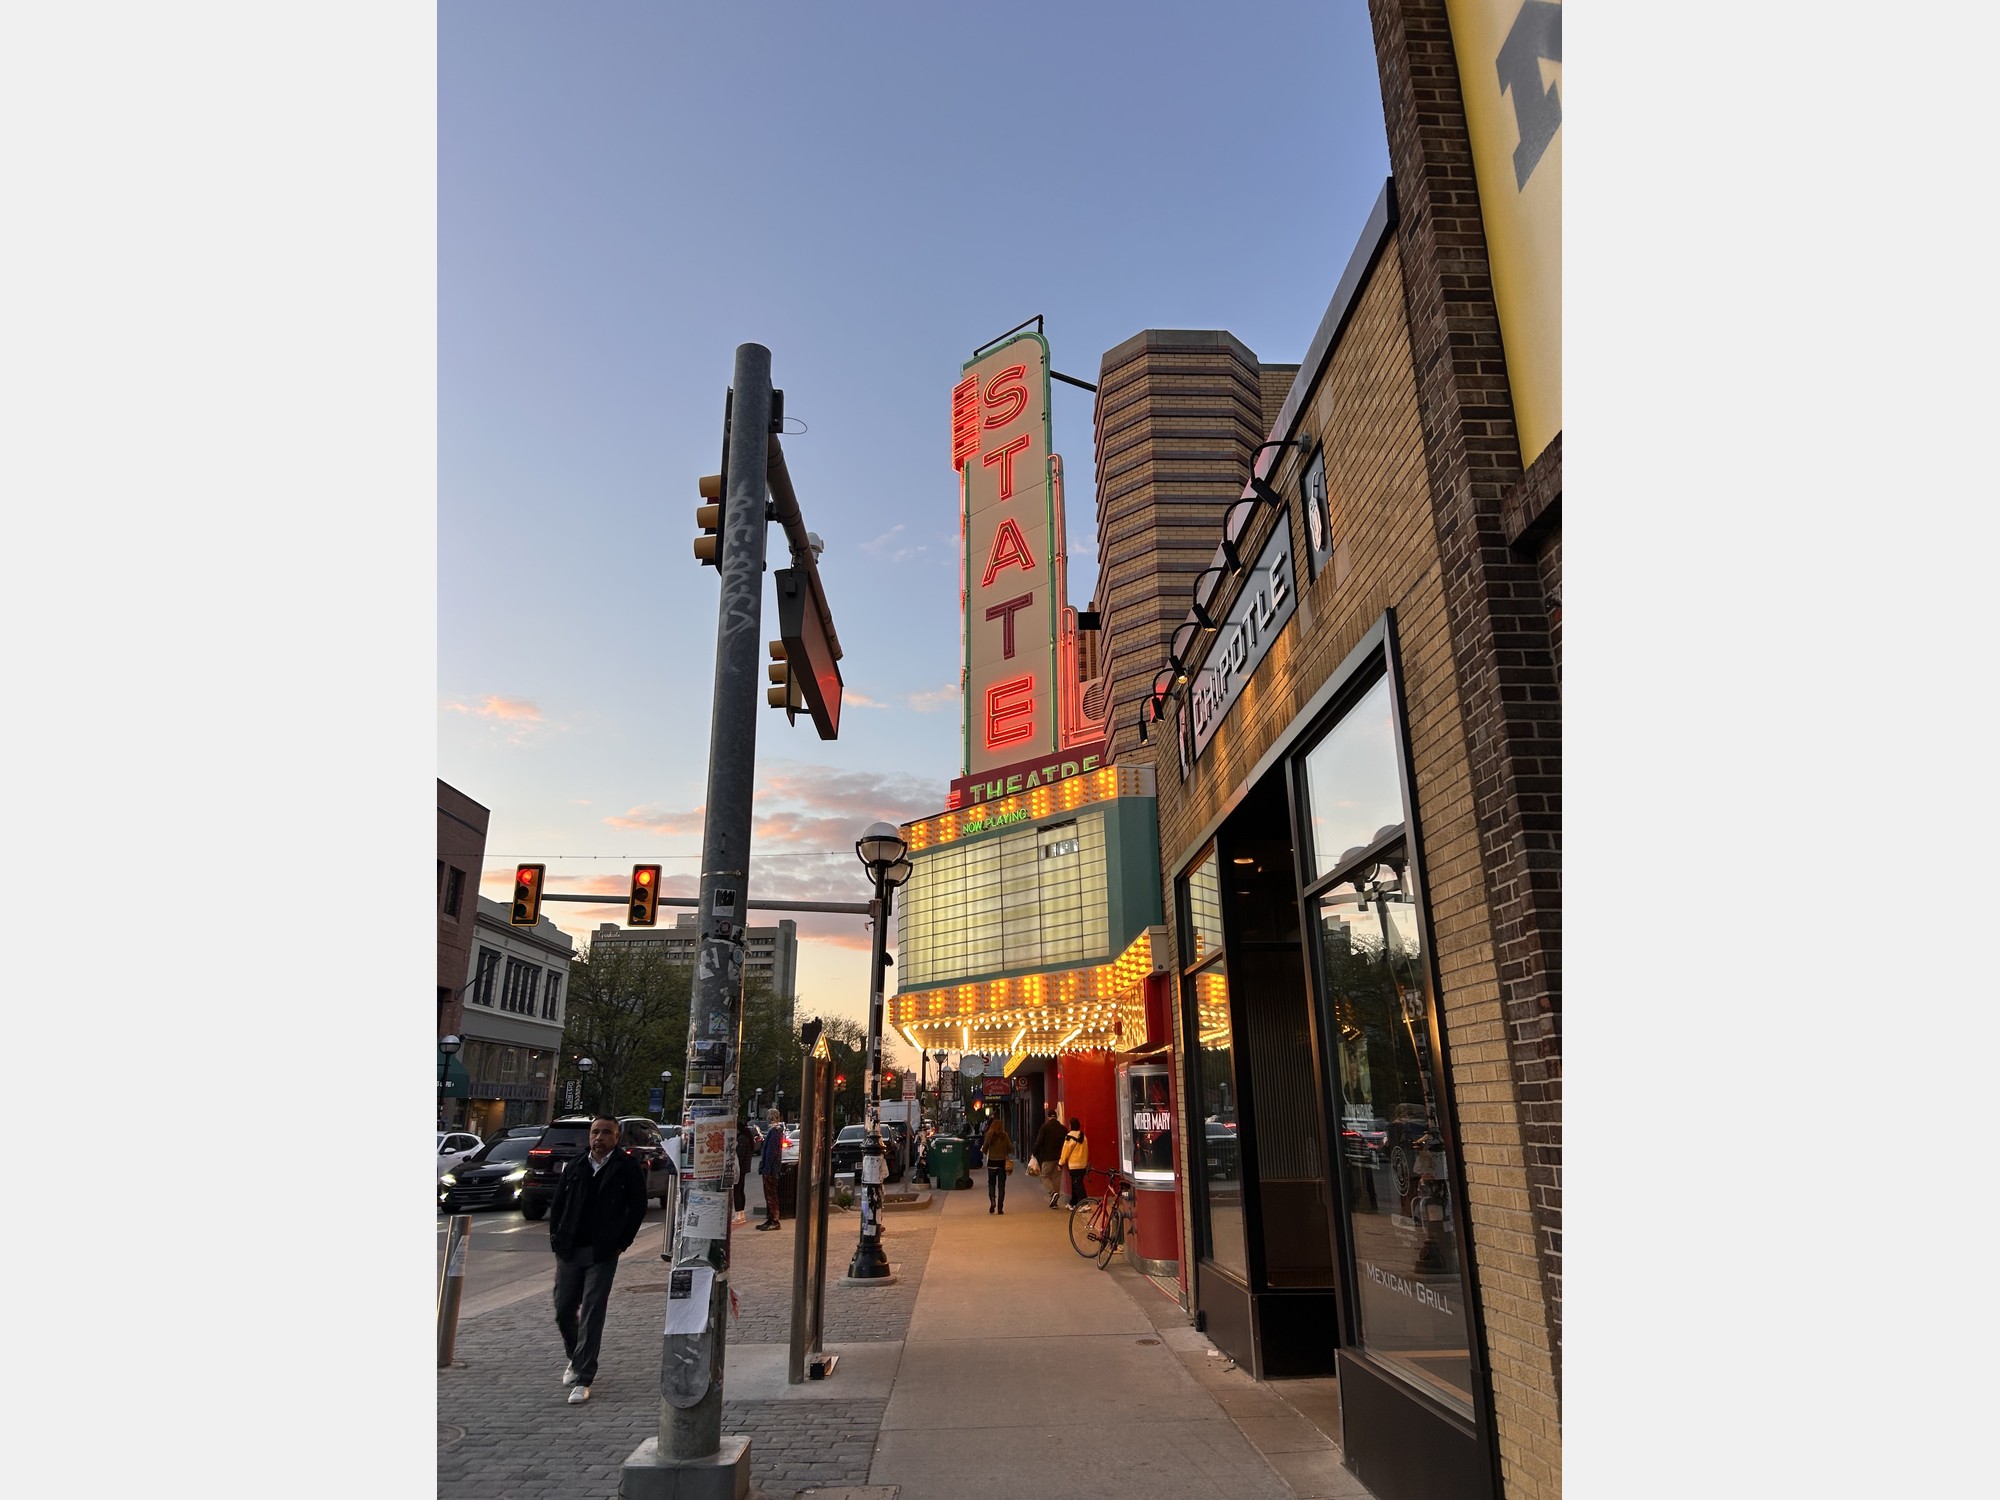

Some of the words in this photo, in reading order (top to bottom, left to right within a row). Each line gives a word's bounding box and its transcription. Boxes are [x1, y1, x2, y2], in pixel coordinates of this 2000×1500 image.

[982, 363, 1036, 749] STATE
[1194, 551, 1291, 737] CHIPOTLE
[970, 754, 1100, 803] THEATRE
[963, 820, 983, 834] NOW
[985, 808, 1028, 829] PLAYING
[1133, 1112, 1151, 1130] MOTHER
[1152, 1112, 1170, 1130] MARY
[1365, 1261, 1413, 1299] MEXICAN
[1415, 1281, 1453, 1316] GRILL
